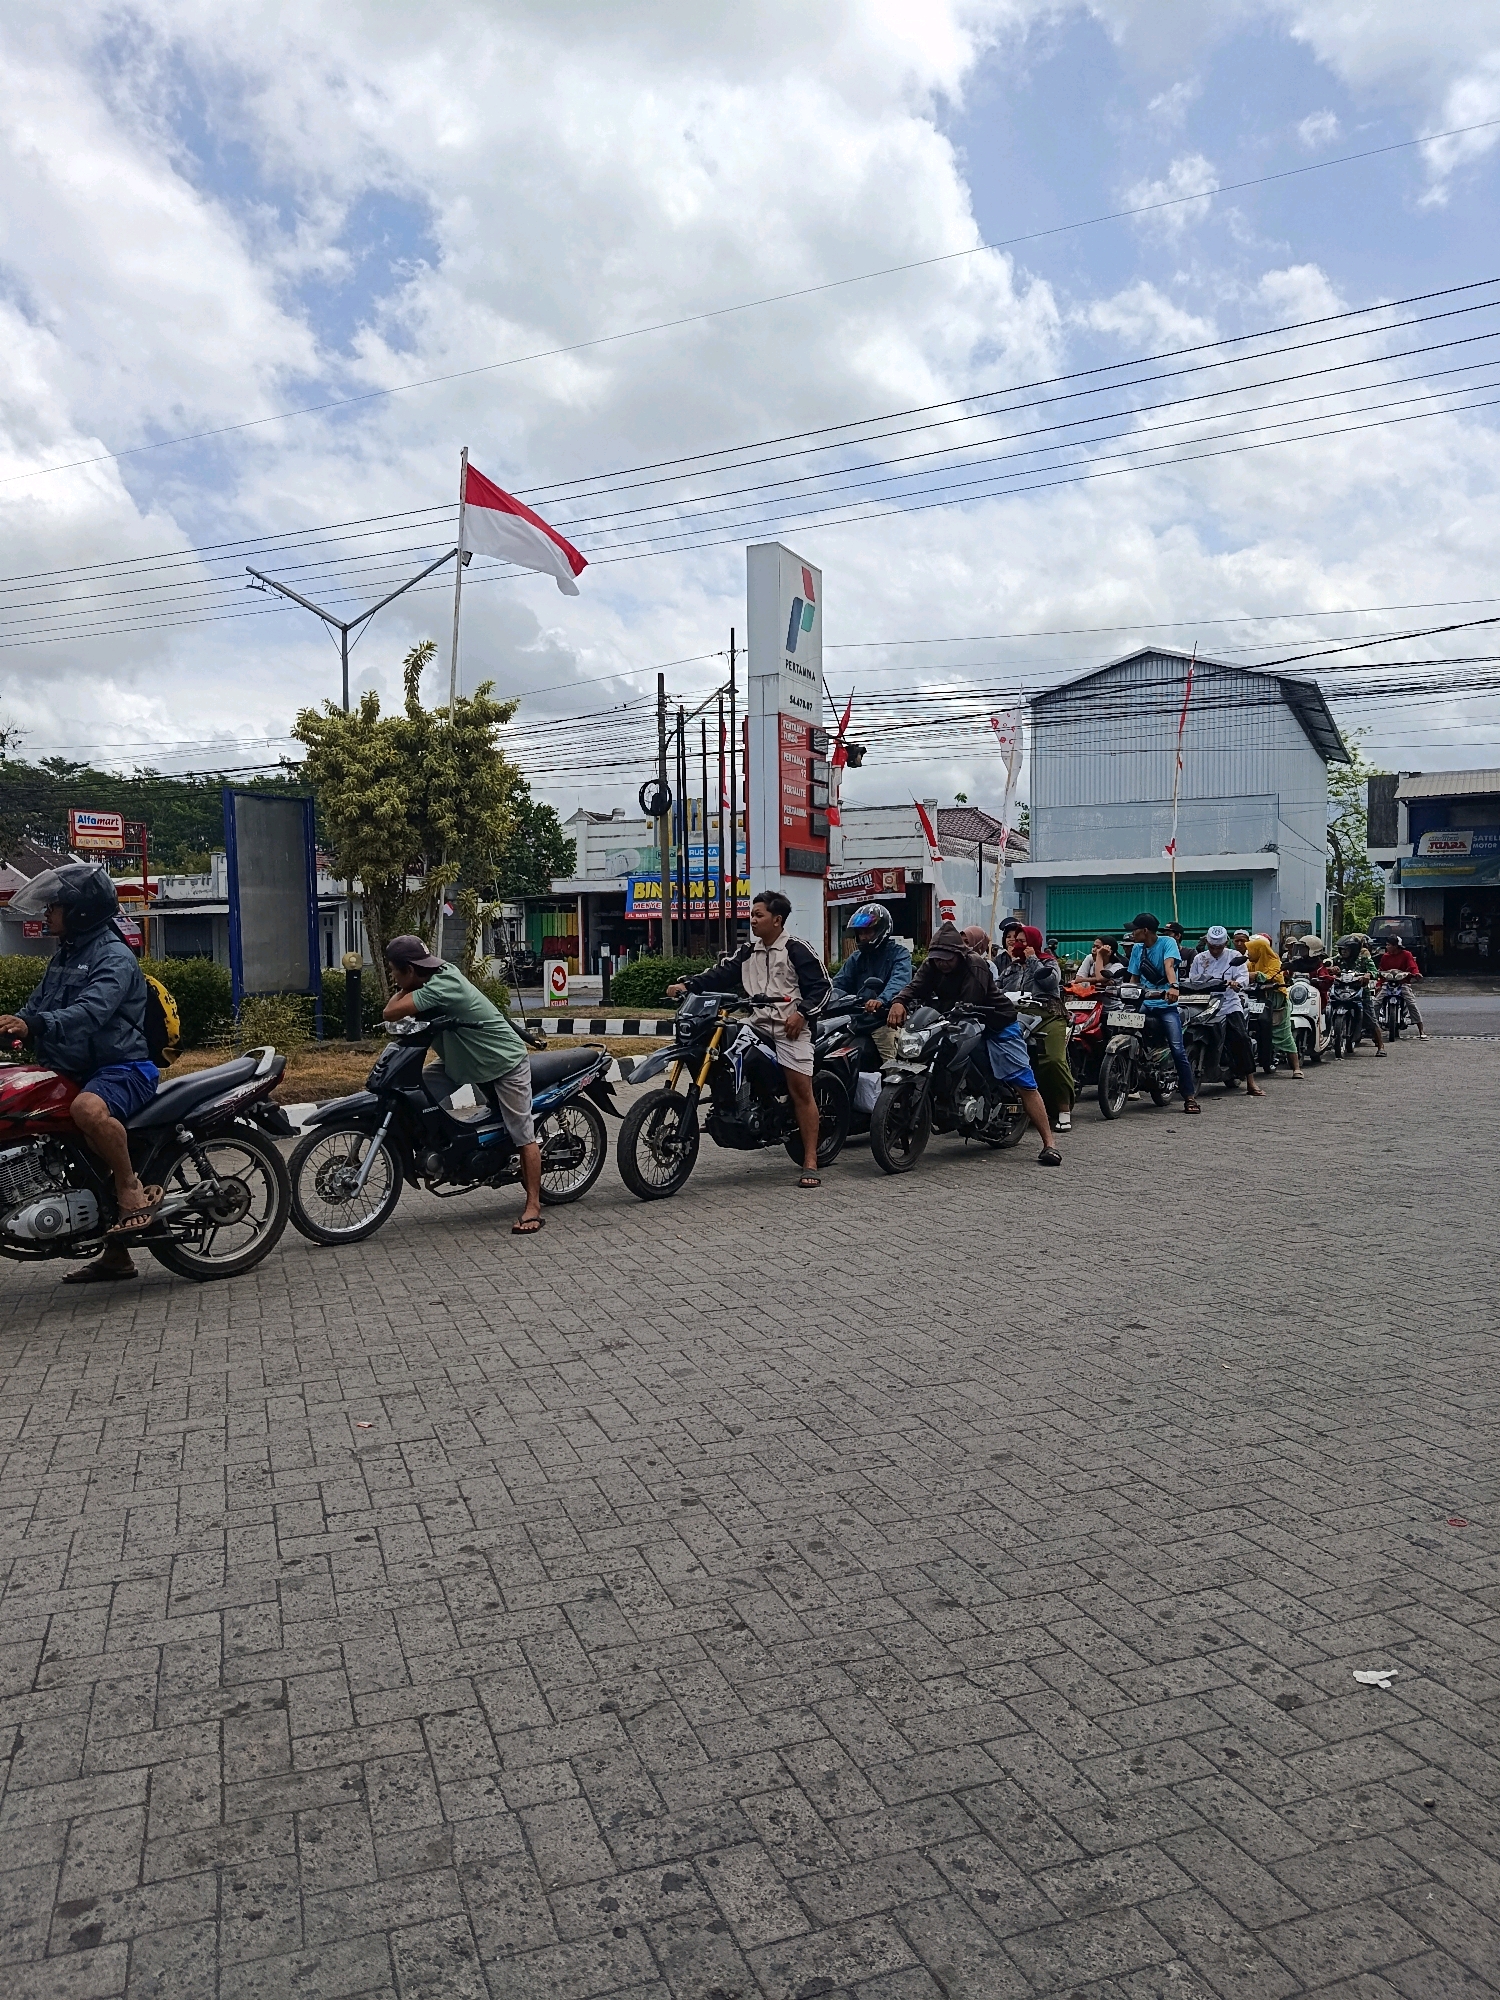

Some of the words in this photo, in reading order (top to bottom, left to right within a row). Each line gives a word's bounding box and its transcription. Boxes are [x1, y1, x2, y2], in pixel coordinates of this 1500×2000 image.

[785, 658, 816, 682] PERTAMINA
[782, 719, 807, 736] PERTAMAX
[783, 752, 807, 768] PERTAMAX
[783, 784, 807, 798] PERTALITE
[77, 814, 119, 826] Alfamart
[689, 848, 718, 856] RUCKA
[1429, 841, 1467, 850] JUARA
[828, 873, 873, 891] MERDEKA!
[551, 999, 568, 1007] KELUAR
